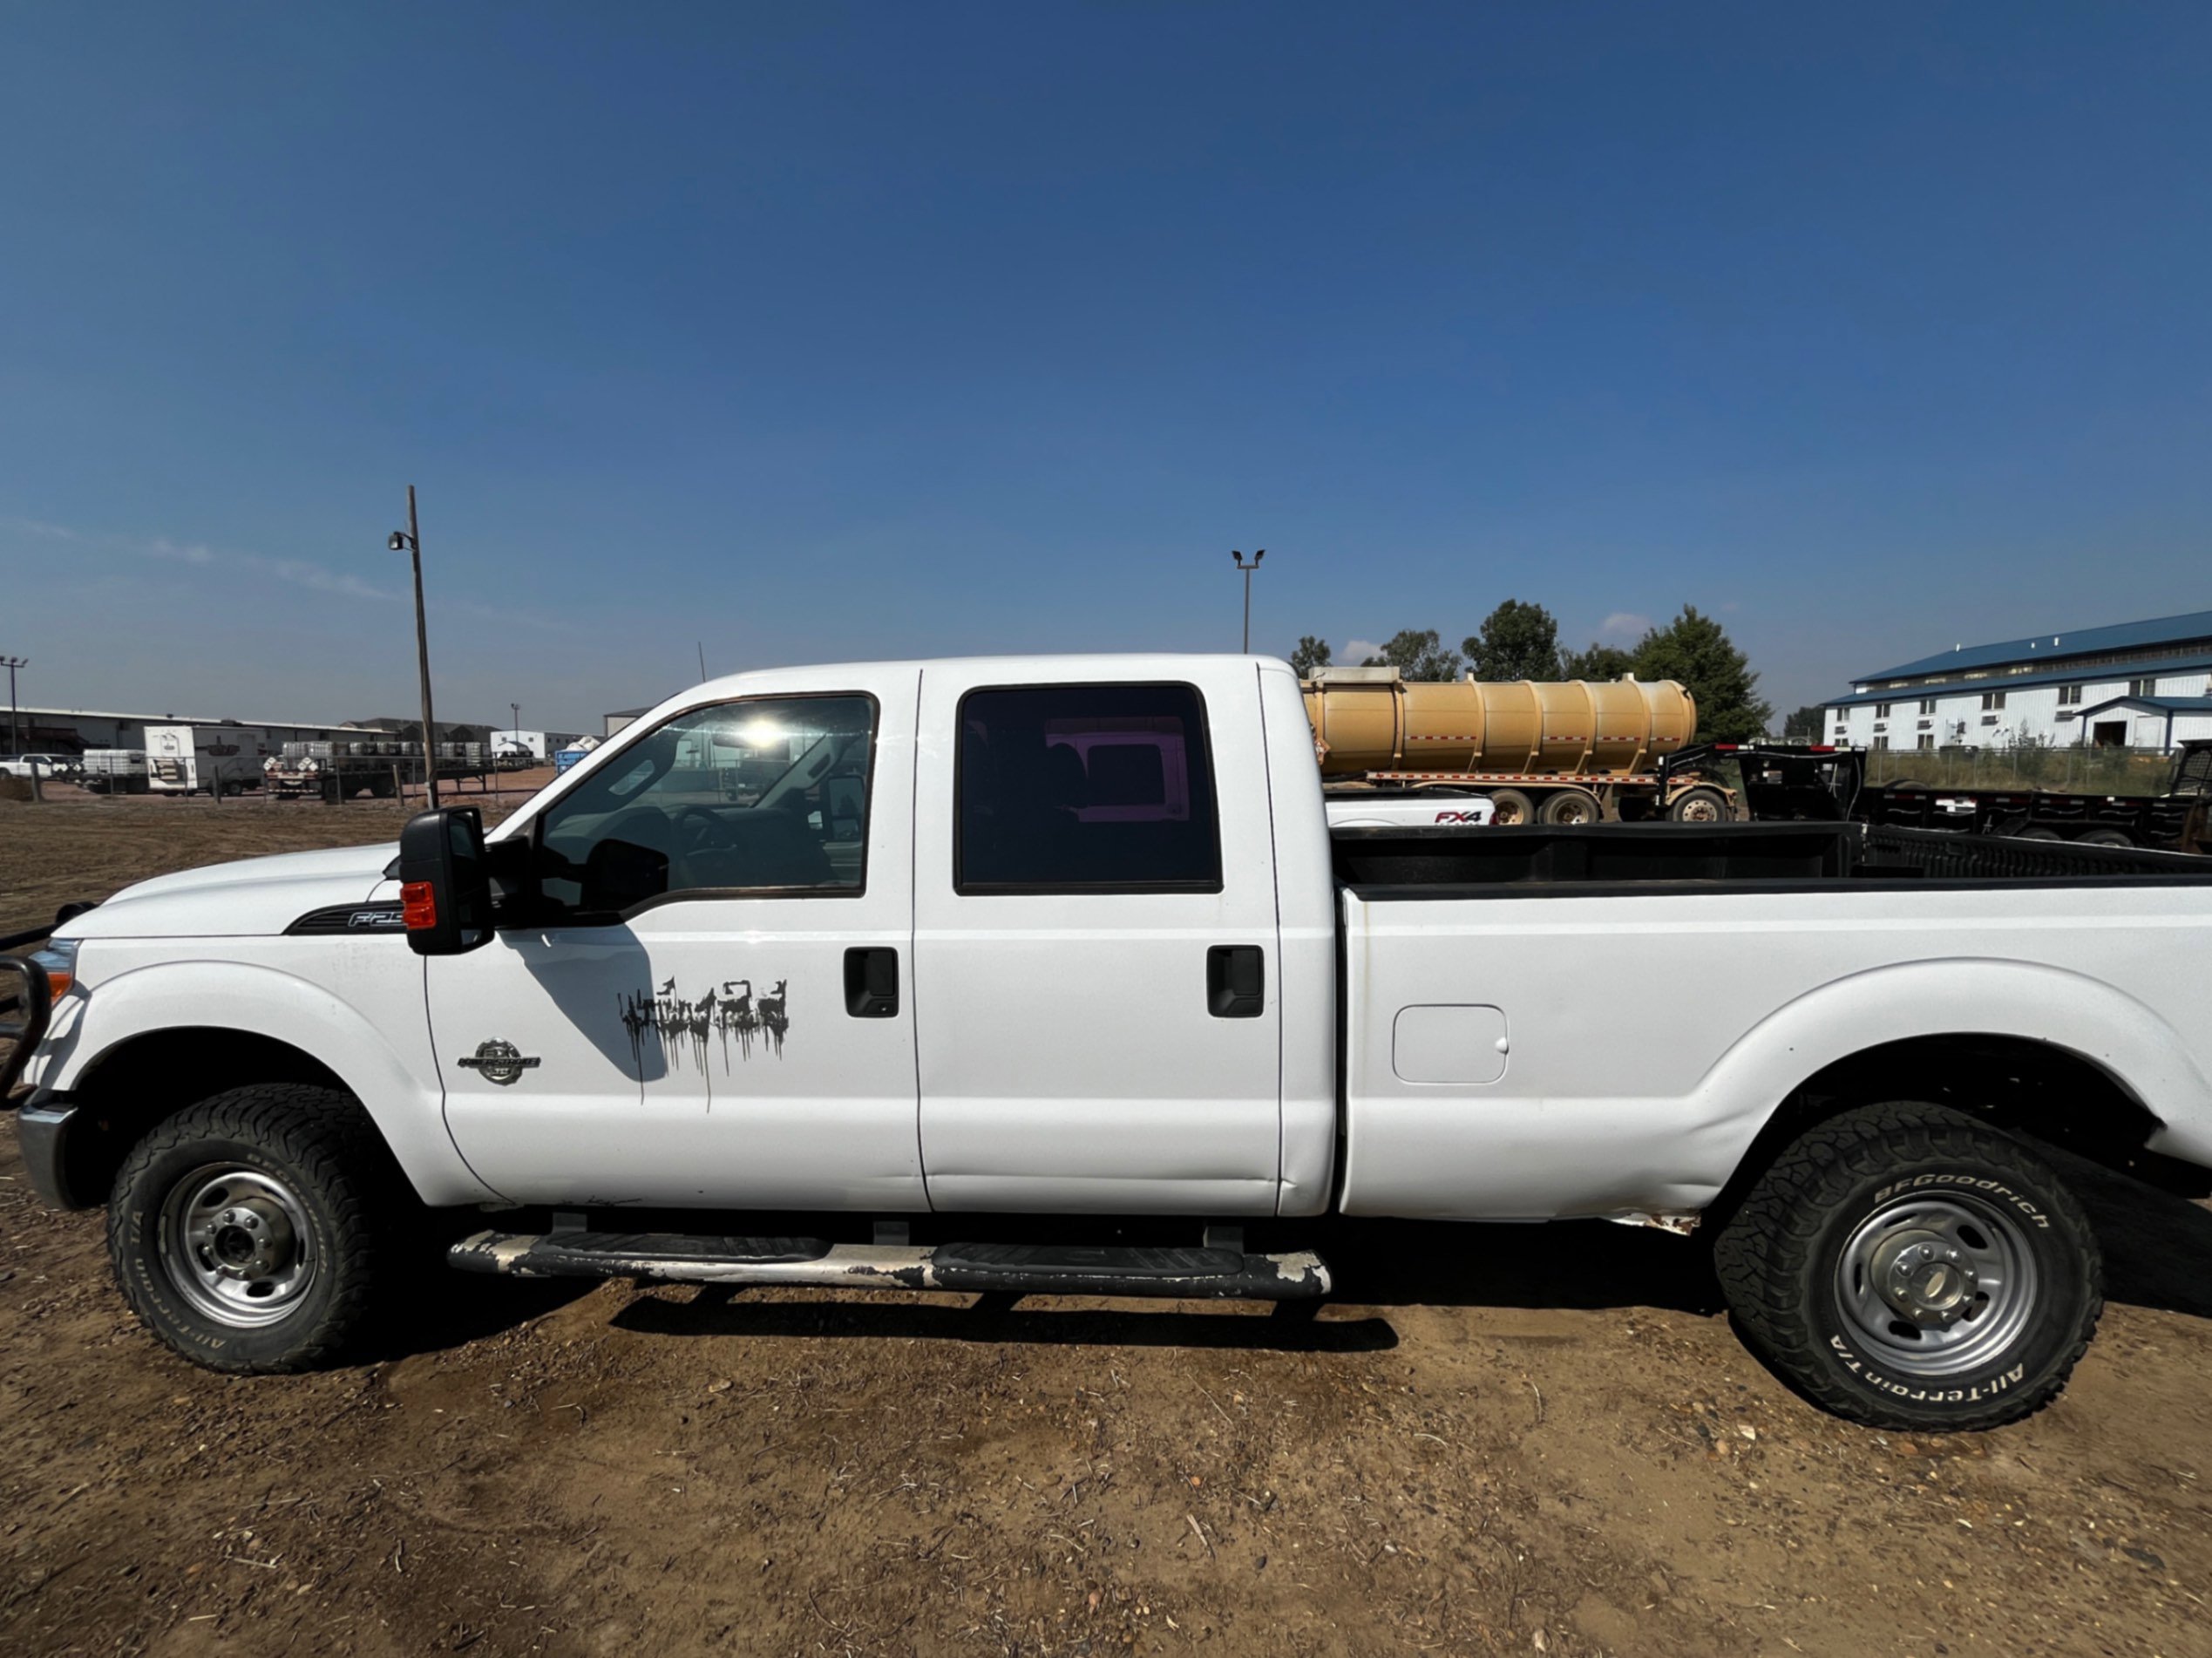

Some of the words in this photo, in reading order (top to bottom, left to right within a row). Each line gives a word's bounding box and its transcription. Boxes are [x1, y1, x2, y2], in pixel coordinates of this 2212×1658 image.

[1435, 811, 1482, 824] FX4
[1875, 1174, 2049, 1228] BFGoodrich
[1830, 1334, 1861, 1374] T/A
[1865, 1362, 2024, 1403] All-Terrain
